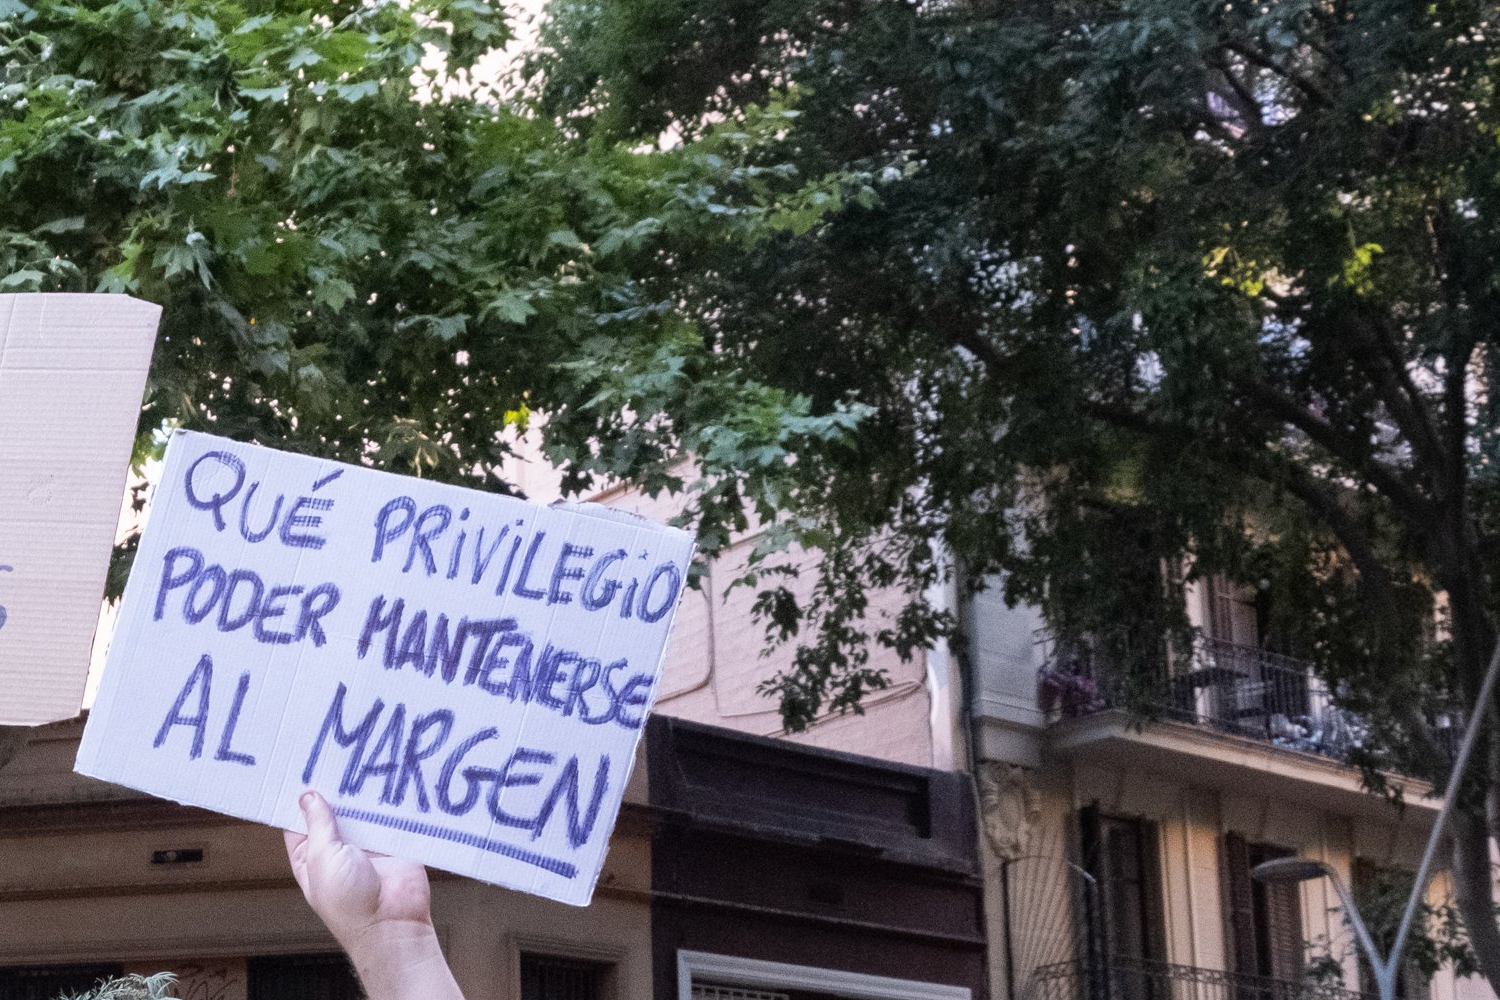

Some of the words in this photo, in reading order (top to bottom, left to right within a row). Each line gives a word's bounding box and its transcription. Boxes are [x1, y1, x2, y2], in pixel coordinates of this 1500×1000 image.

[184, 450, 344, 550] QUÉ
[153, 546, 342, 648] PODER
[357, 594, 655, 731] MANTENERSE
[152, 653, 257, 767] AL
[301, 681, 611, 850] MARGEN
